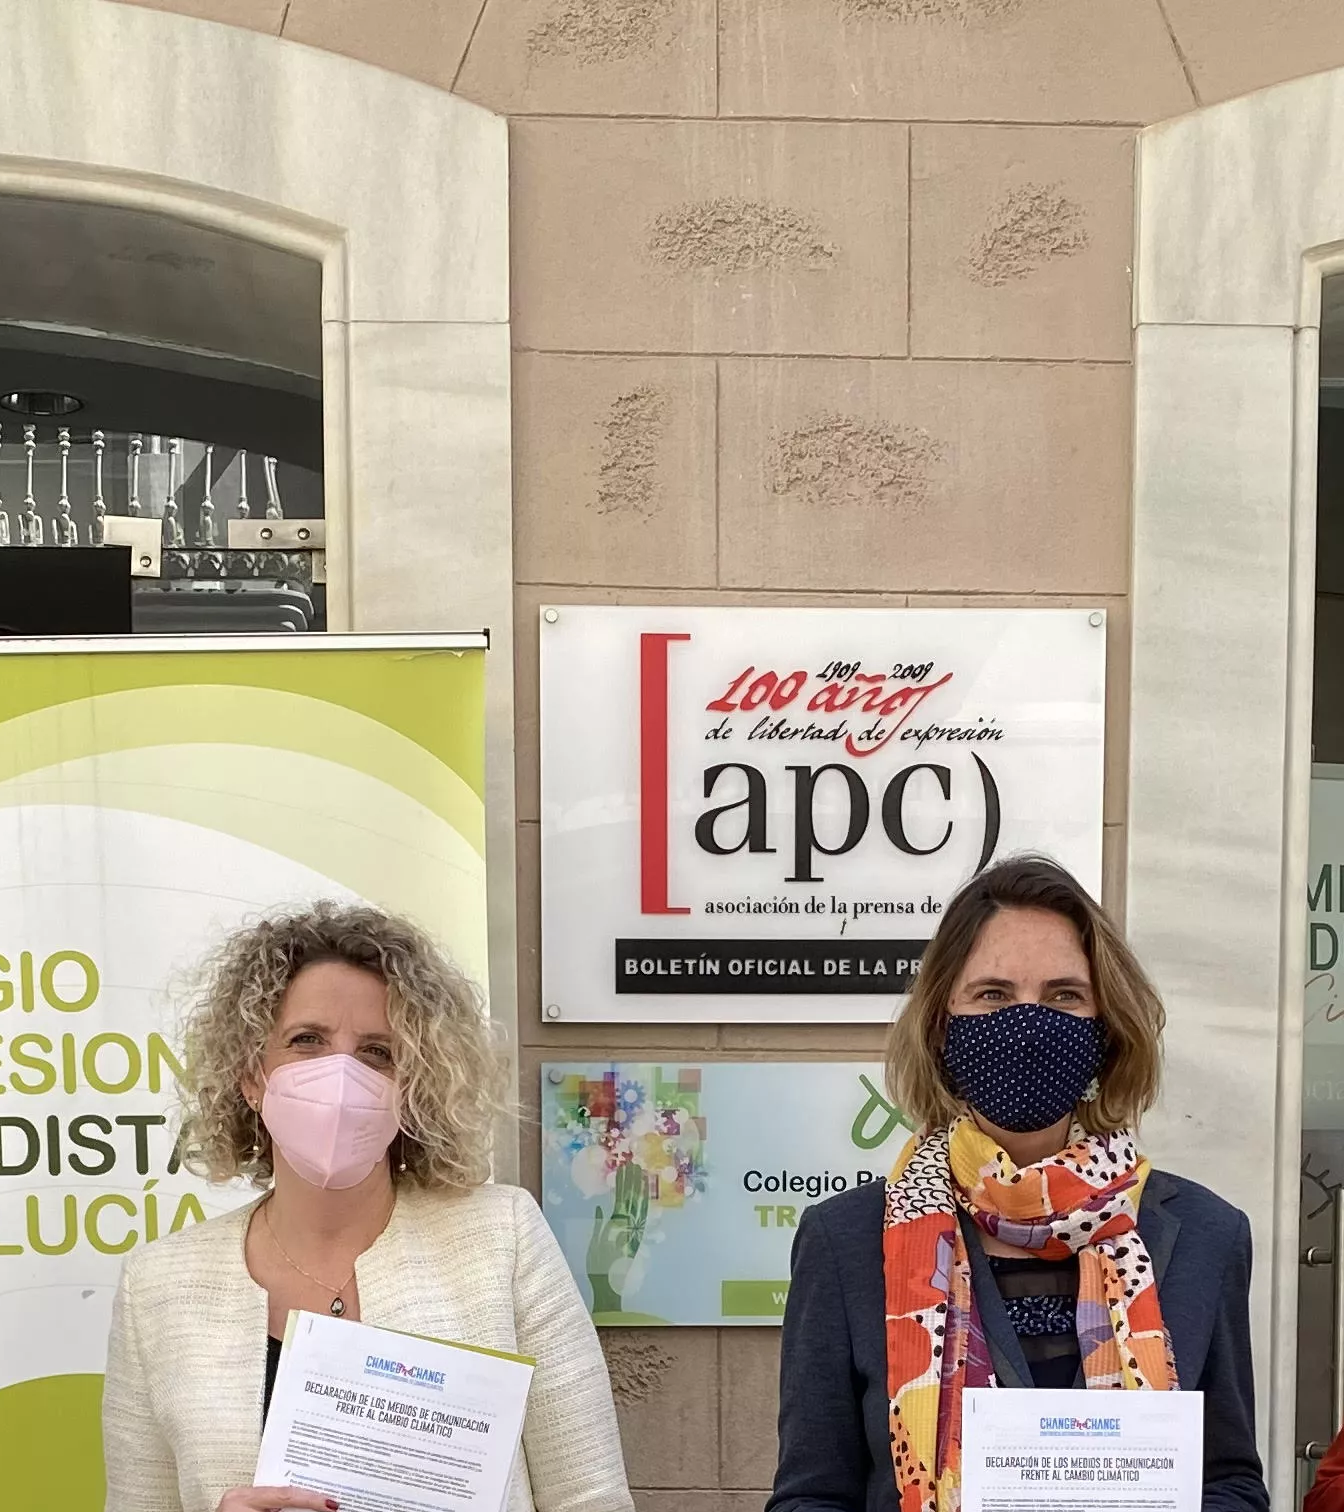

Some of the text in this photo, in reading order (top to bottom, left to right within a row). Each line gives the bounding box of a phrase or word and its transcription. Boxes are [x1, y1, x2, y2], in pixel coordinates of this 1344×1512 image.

[816, 661, 935, 681] 1909 2009
[706, 666, 954, 758] 100 años
[705, 716, 1005, 751] de libertad de expresión
[705, 896, 943, 919] asociación de la prensa de
[624, 952, 720, 976] BOLETÍN
[727, 959, 816, 976] OFICIAL
[823, 959, 851, 976] DE
[859, 959, 888, 976] LA
[743, 1170, 847, 1198] Colegio
[335, 1401, 365, 1418] FRENTE
[366, 1408, 376, 1420] AL
[378, 1411, 409, 1428] CAMBIO
[358, 1393, 369, 1405] DE
[370, 1397, 387, 1409] LOS
[387, 1401, 418, 1418] MEDIOS
[419, 1407, 430, 1420] DE
[1020, 1469, 1050, 1481] FRENTE
[1052, 1470, 1062, 1481] AL
[1064, 1470, 1095, 1481] CAMBIO
[1041, 1457, 1052, 1468] DE
[1053, 1457, 1068, 1468] LOS
[1071, 1457, 1101, 1469] MEDIOS
[1103, 1457, 1113, 1469] DE
